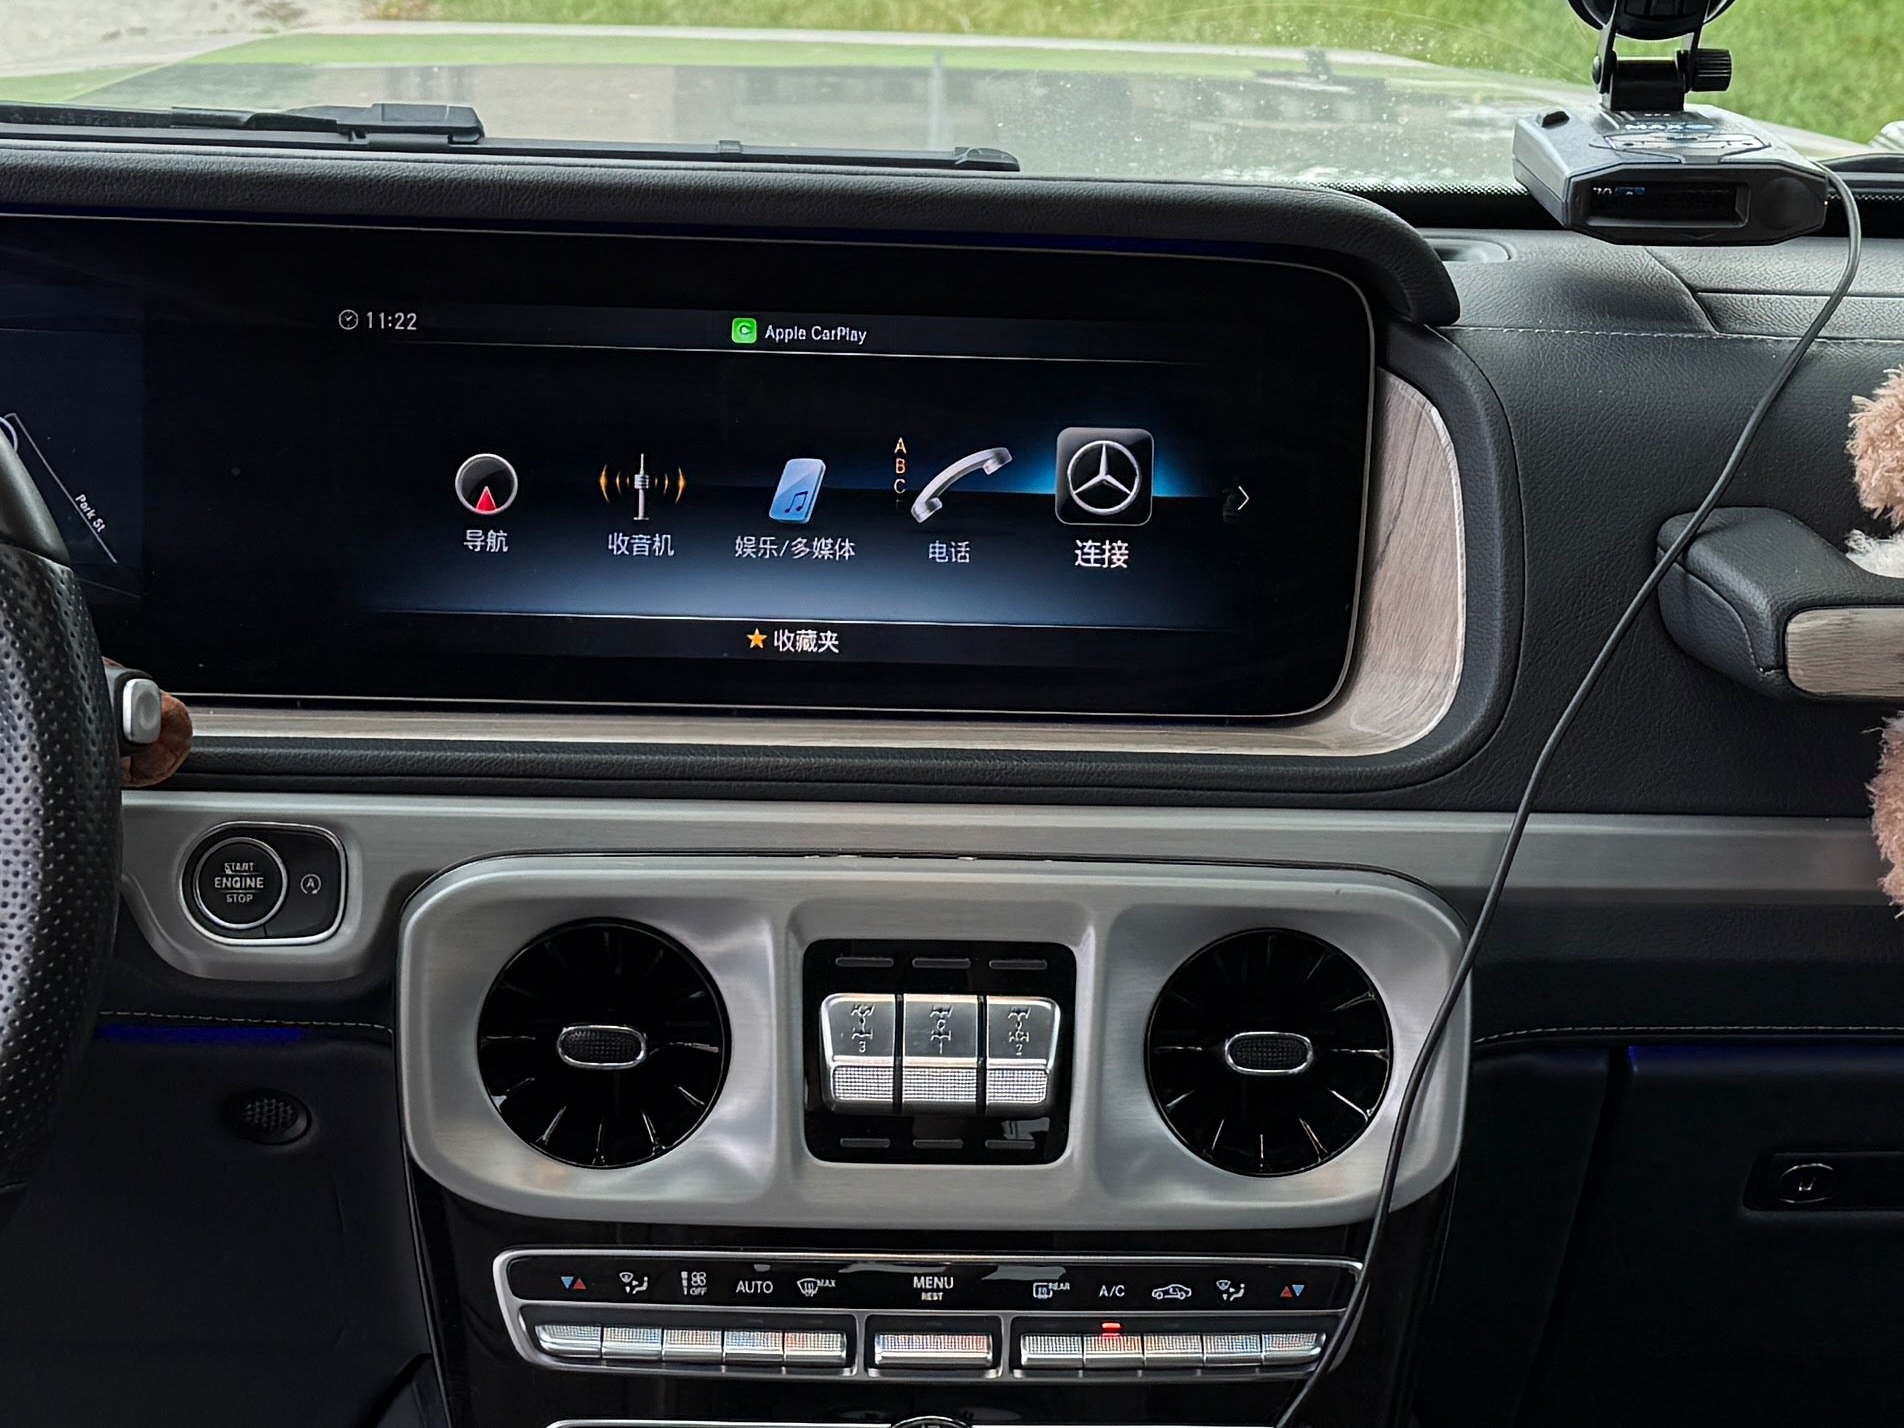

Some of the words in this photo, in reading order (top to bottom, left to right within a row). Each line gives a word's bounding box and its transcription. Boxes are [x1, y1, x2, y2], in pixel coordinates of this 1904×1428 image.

[365, 311, 418, 331] 11:22
[764, 324, 807, 343] Apple
[811, 324, 867, 345] CarPlay
[893, 437, 907, 454] A
[894, 457, 907, 474] B
[893, 478, 907, 495] C
[75, 493, 96, 520] Park
[93, 517, 106, 534] St
[462, 528, 509, 553] 导航
[607, 532, 675, 558] 收音机
[734, 535, 856, 561] 娱乐/多媒体
[928, 540, 971, 564] 电话
[1074, 539, 1130, 569] 连接
[773, 629, 840, 654] 收藏夹
[224, 862, 254, 872] START
[214, 877, 264, 889] ENGINE
[226, 894, 253, 904] STOP
[858, 1040, 867, 1053] 3
[938, 1041, 944, 1054] 1
[1015, 1043, 1023, 1055] 2
[689, 1287, 708, 1296] OFF
[735, 1281, 773, 1294] AUTO
[913, 1276, 954, 1290] MENU
[1098, 1285, 1126, 1298] A/C
[921, 1292, 944, 1301] REST
